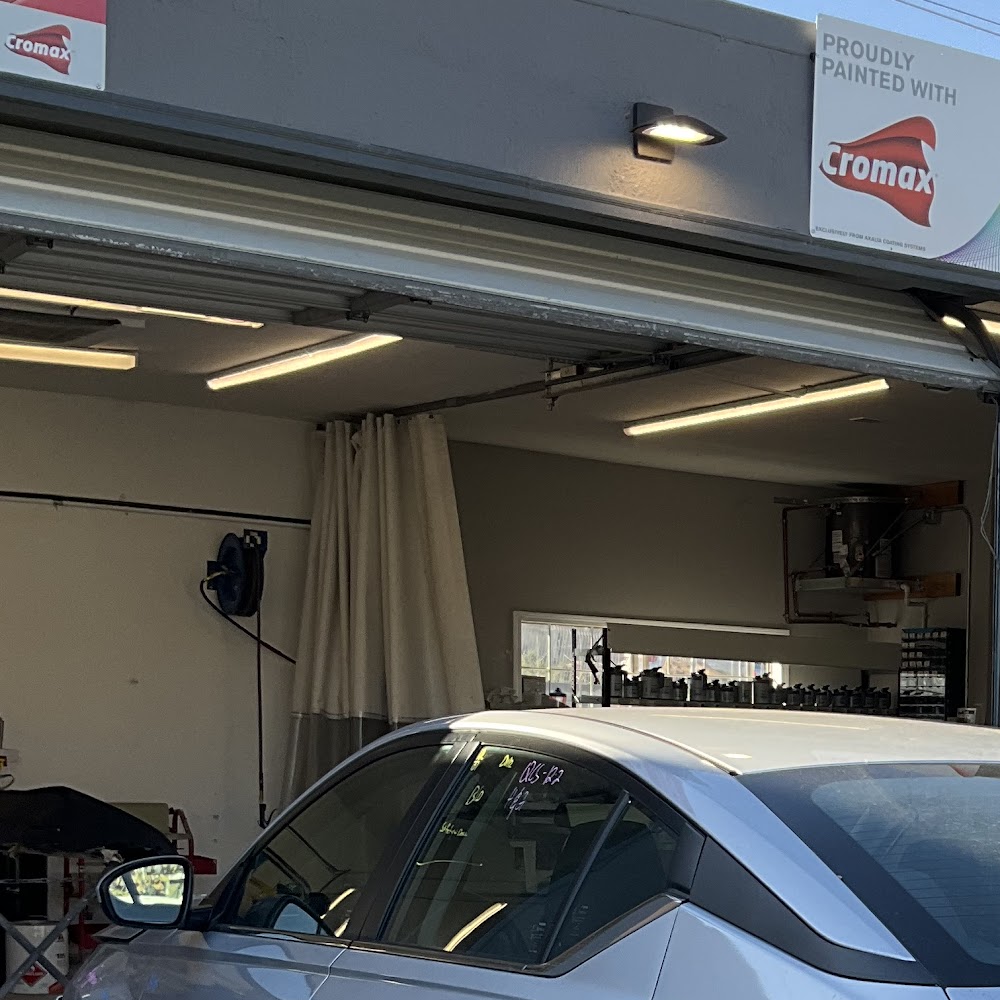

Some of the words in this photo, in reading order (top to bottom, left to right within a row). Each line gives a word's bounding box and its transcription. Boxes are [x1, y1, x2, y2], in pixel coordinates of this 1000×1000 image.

[823, 33, 915, 71] PROUDLY
[822, 57, 905, 93] PAINTED
[911, 78, 957, 106] WITH
[821, 143, 934, 195] Cromax
